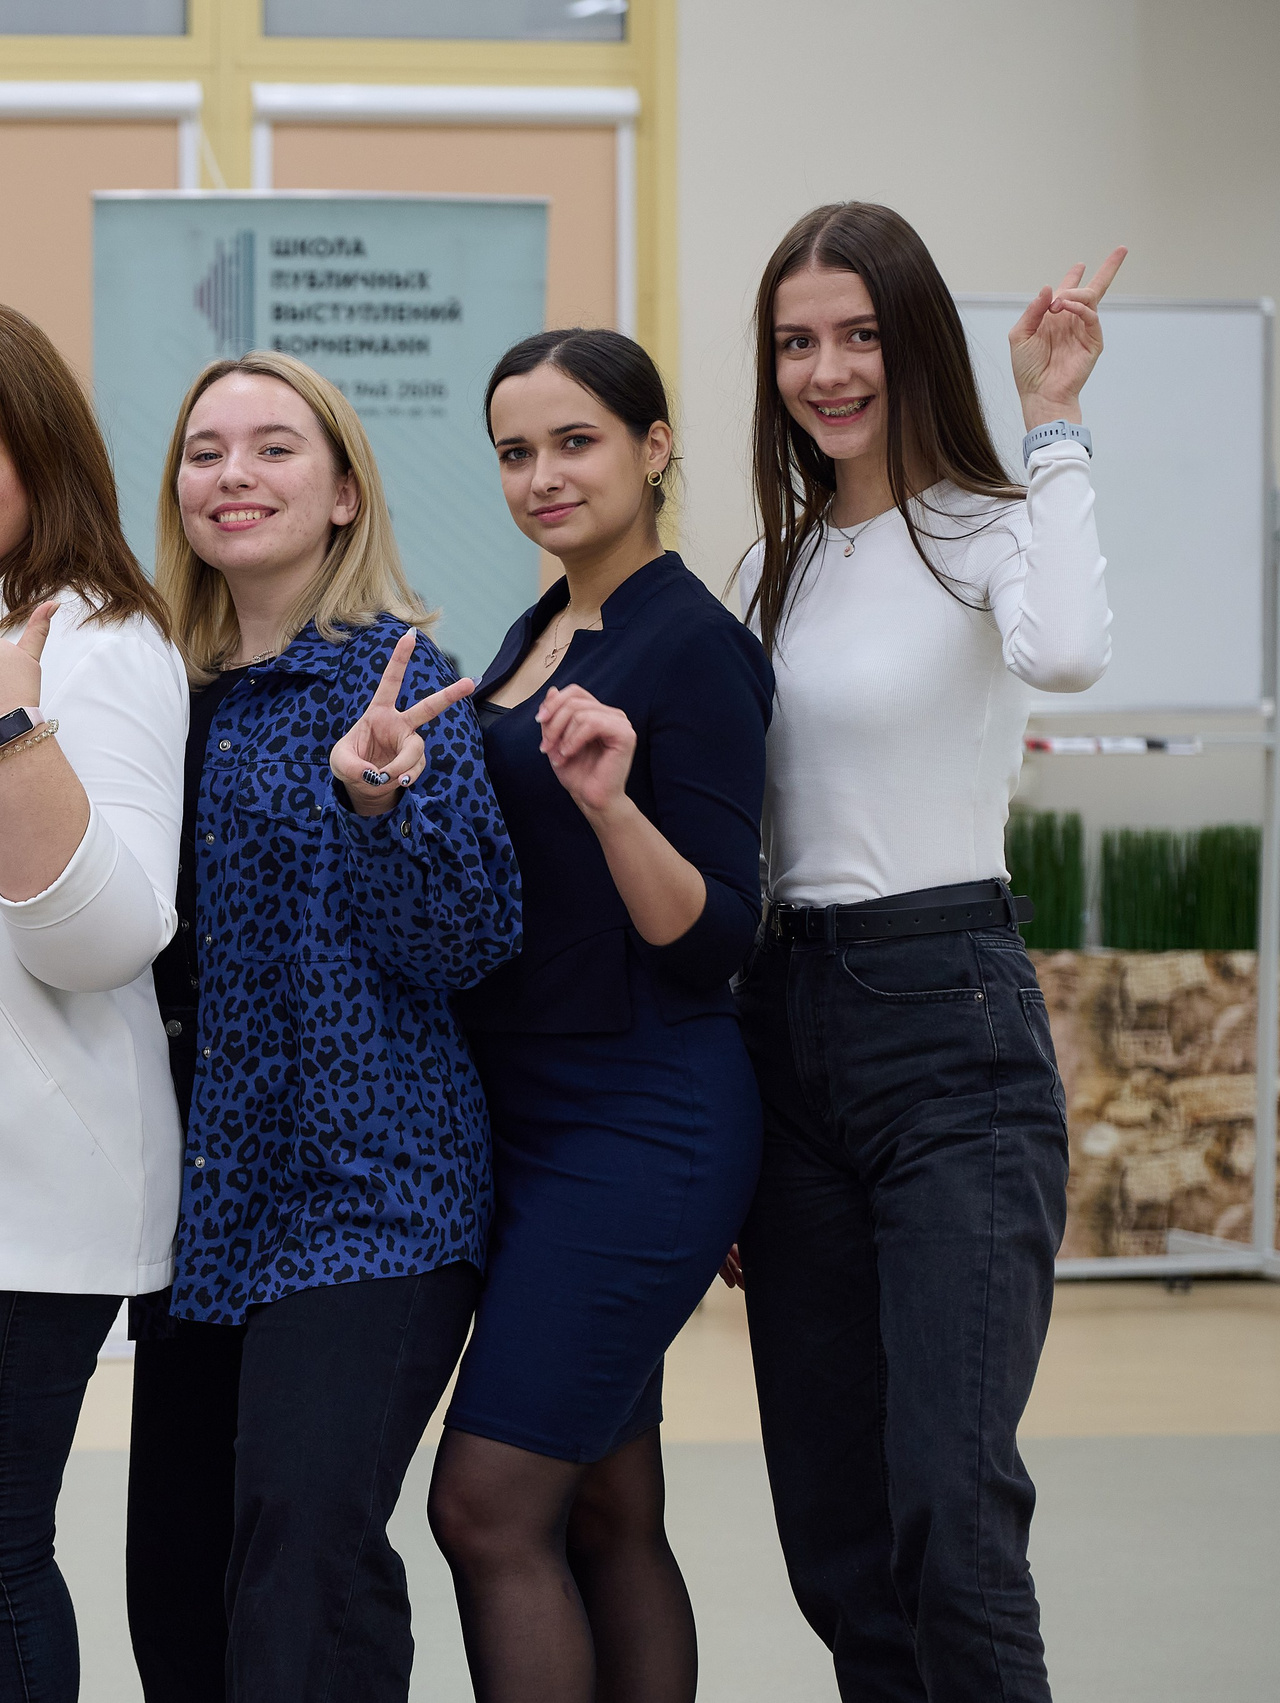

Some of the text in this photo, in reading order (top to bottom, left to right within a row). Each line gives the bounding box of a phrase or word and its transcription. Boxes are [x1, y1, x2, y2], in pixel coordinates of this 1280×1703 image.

[270, 237, 367, 257] ШКОЛА
[270, 270, 431, 290] ПУБЛИЧНЫХ
[270, 296, 463, 322] ВЫСТУПЛЕНИЙ
[271, 336, 430, 356] БОРНЕМАНН
